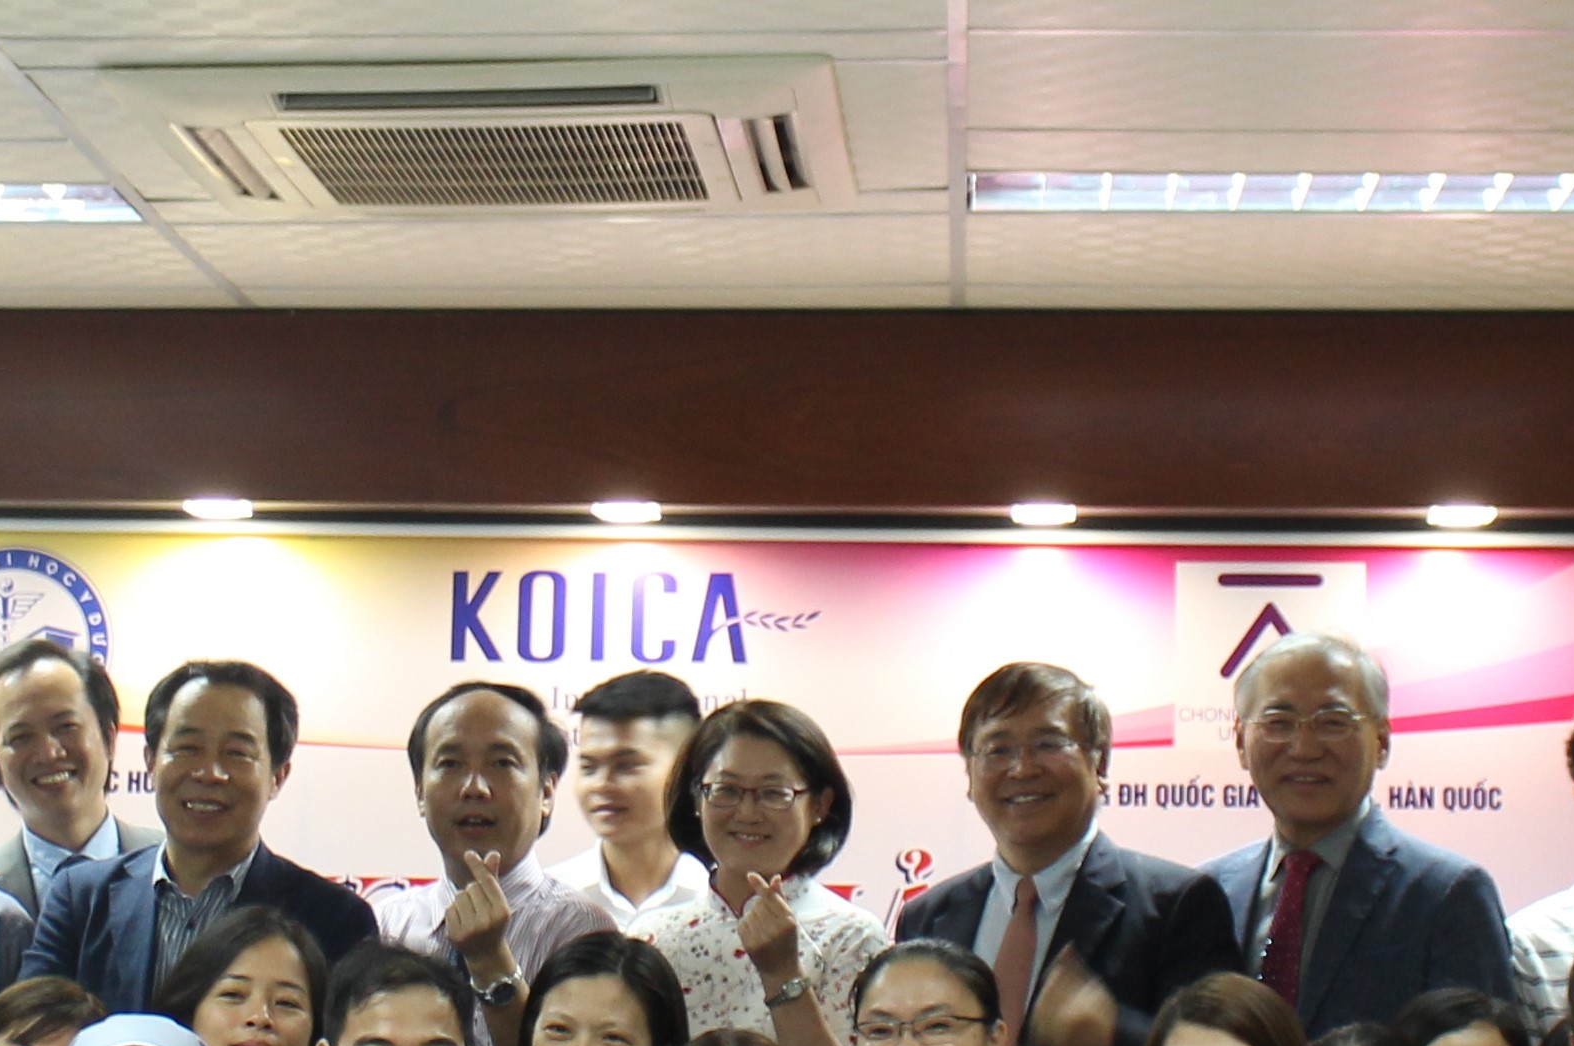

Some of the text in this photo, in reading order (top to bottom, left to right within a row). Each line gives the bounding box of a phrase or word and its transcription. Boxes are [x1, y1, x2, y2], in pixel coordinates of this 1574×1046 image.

[78, 590, 94, 604] Y
[450, 570, 749, 665] KOICA
[1118, 783, 1148, 807] ĐH
[1155, 773, 1216, 810] QUỐC
[1222, 784, 1261, 809] GIA
[1442, 778, 1503, 814] QUỐC
